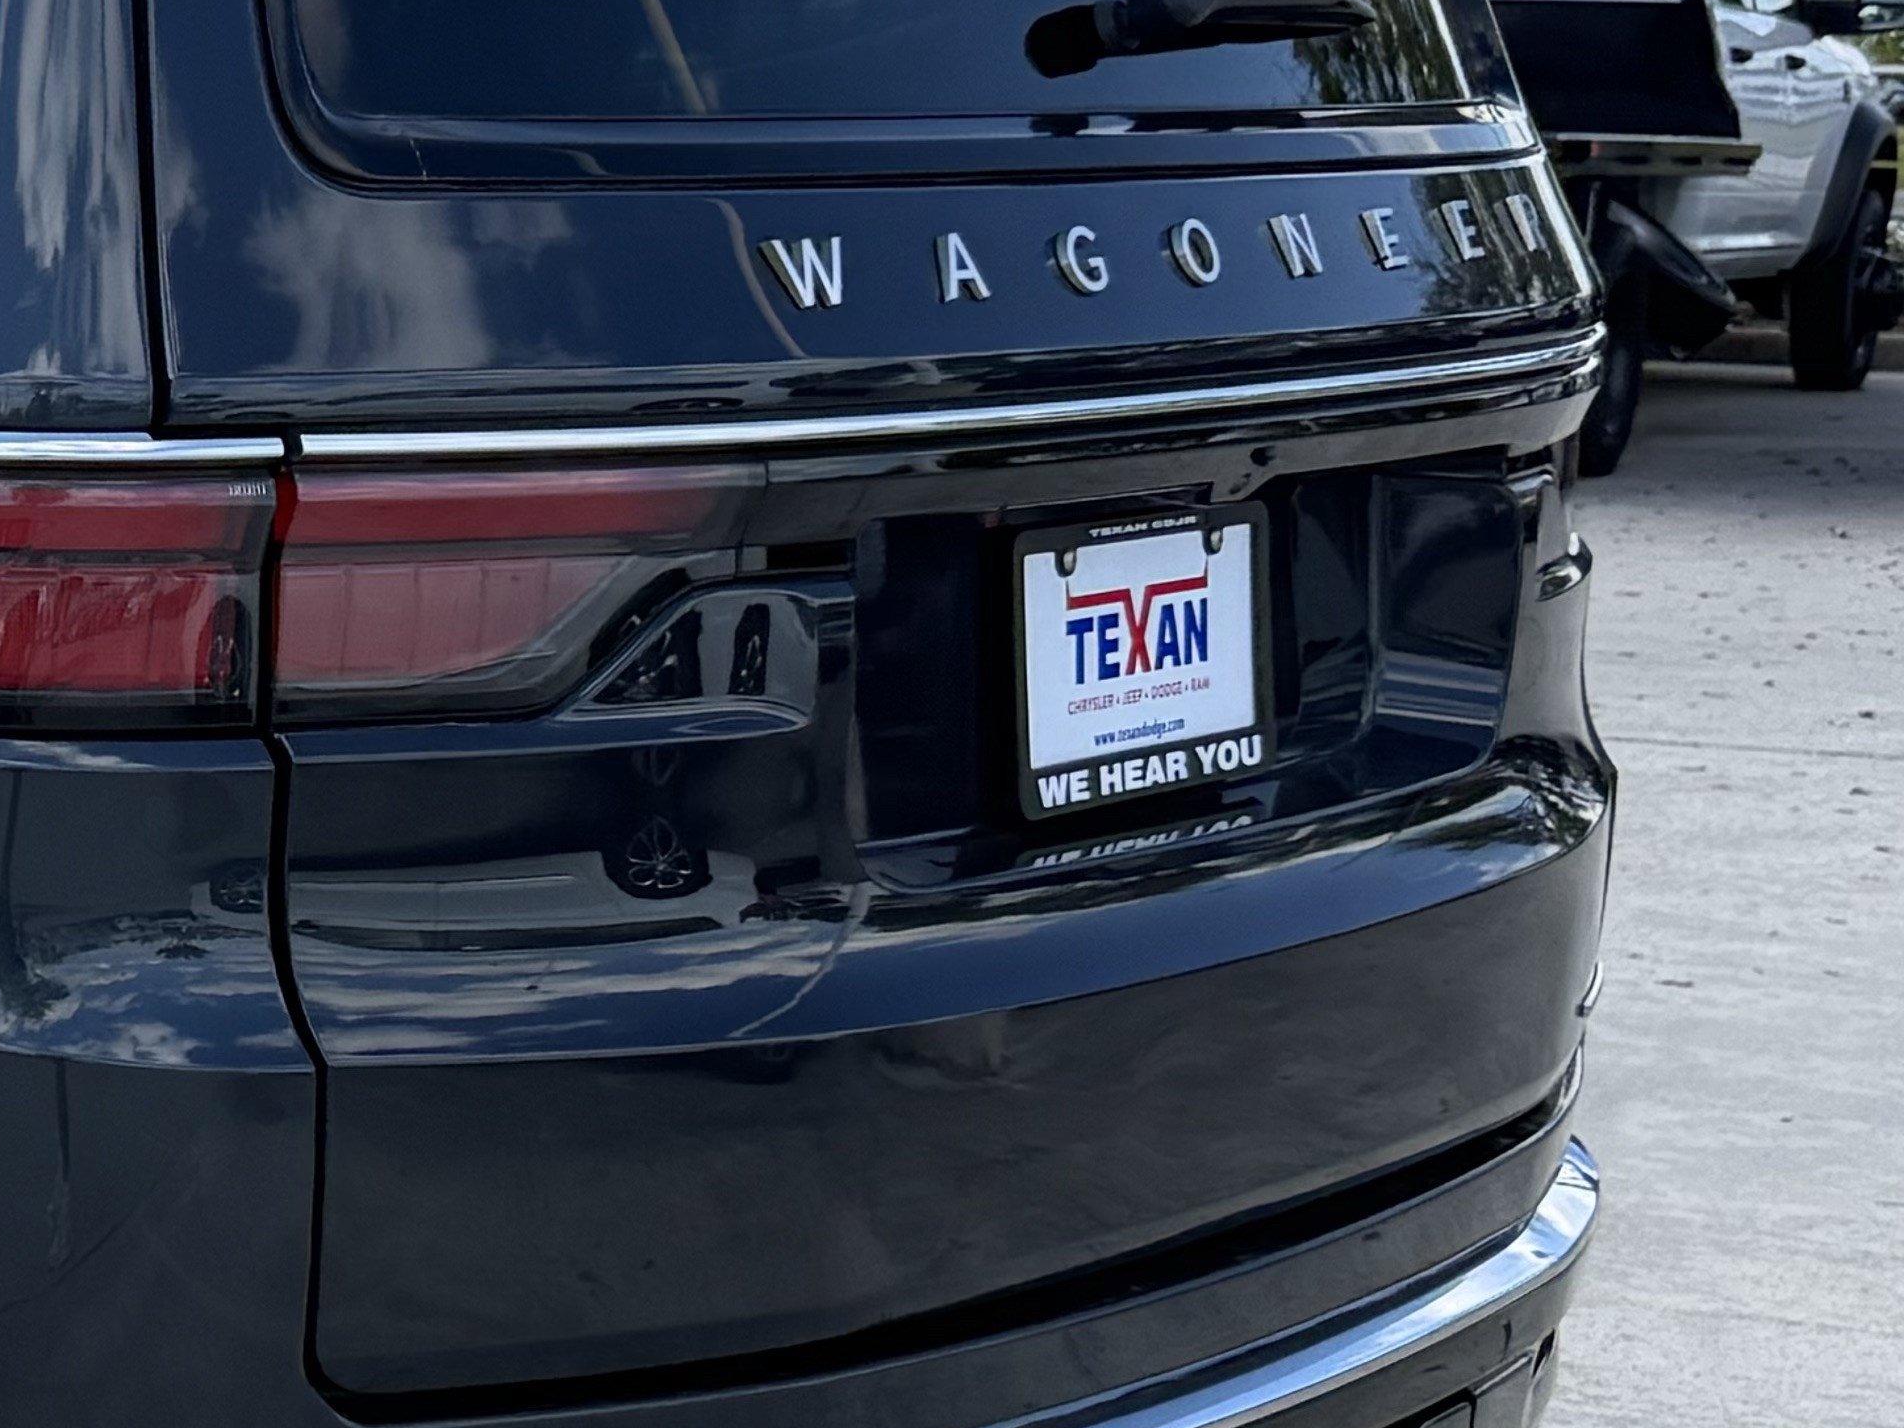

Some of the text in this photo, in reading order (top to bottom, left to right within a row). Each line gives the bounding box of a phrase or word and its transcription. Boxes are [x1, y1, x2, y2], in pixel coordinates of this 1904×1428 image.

[758, 192, 1552, 310] WAGONEER
[1065, 584, 1209, 685] TEXAN
[1150, 681, 1183, 700] DODGE
[1037, 734, 1263, 810] WE HEAR YOU
